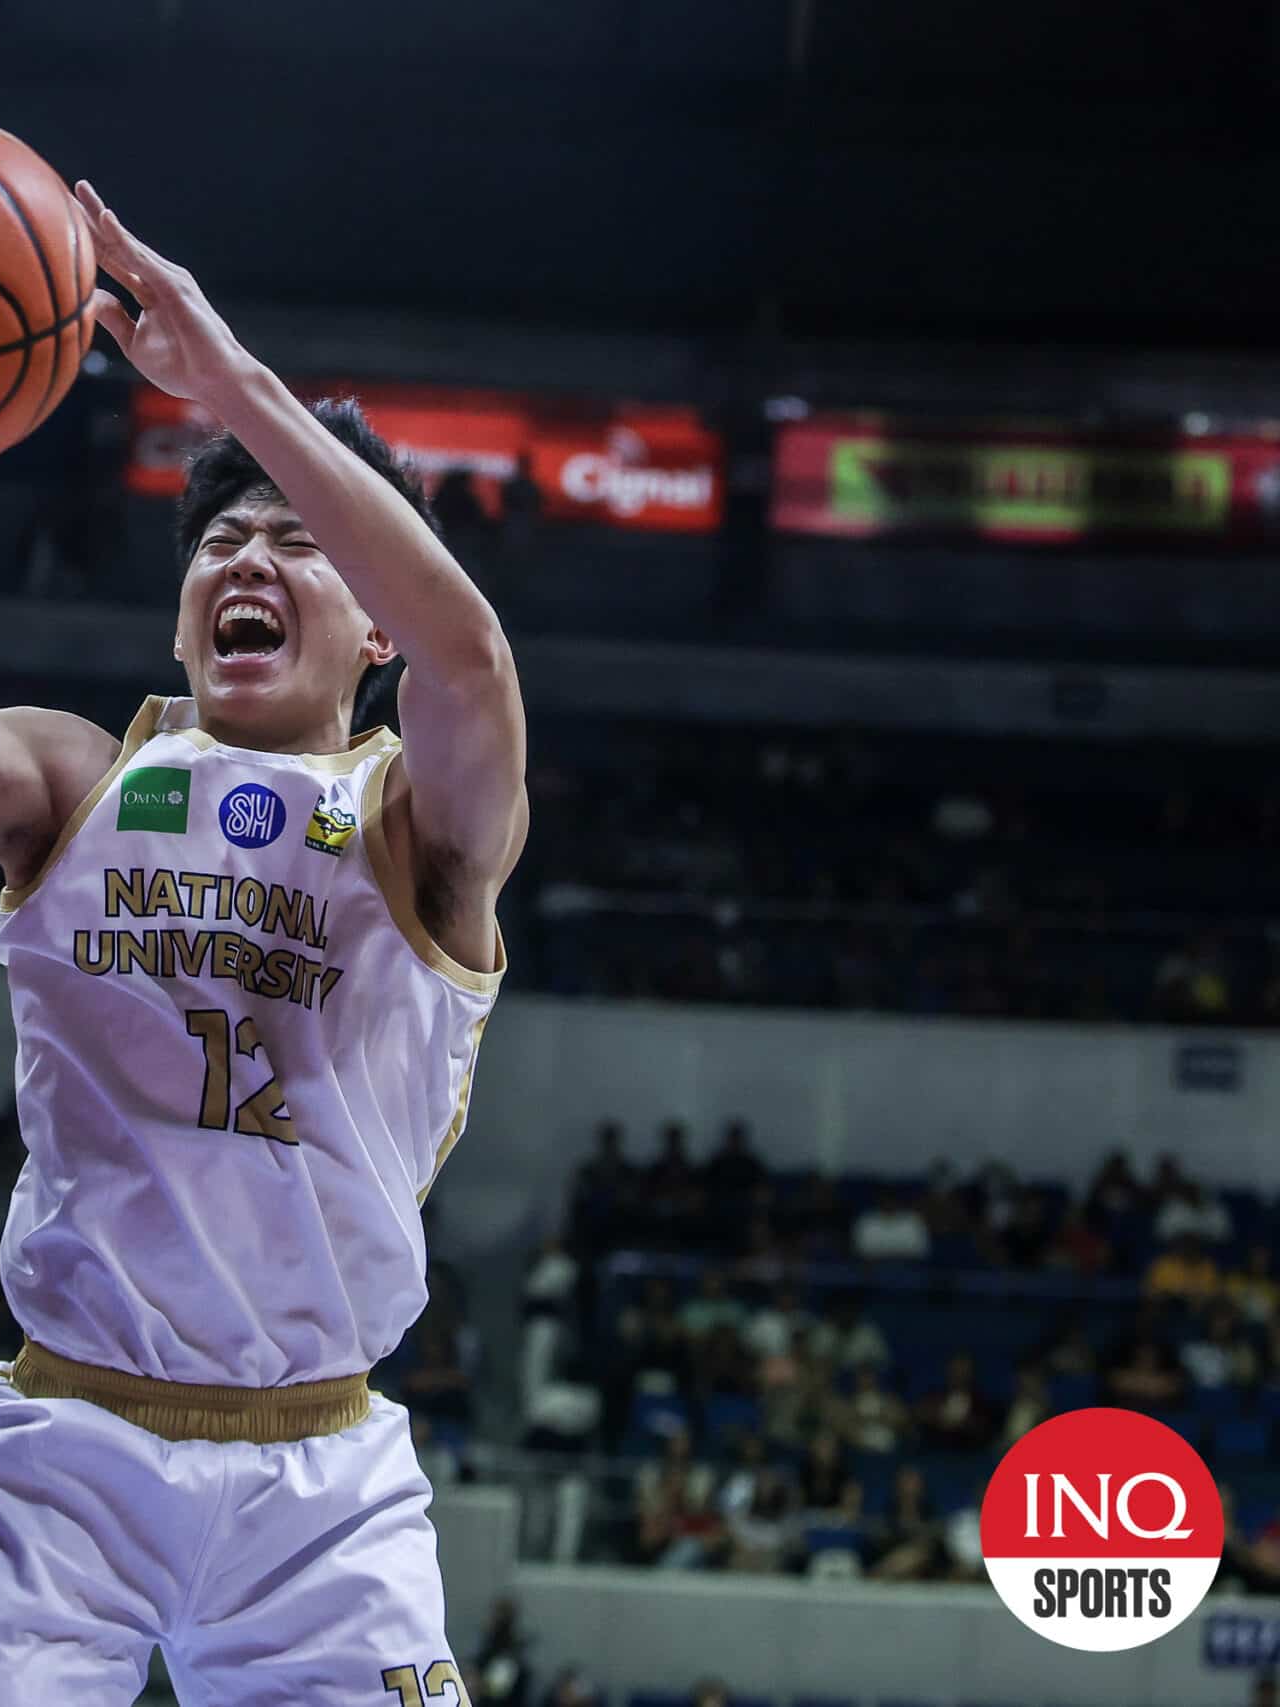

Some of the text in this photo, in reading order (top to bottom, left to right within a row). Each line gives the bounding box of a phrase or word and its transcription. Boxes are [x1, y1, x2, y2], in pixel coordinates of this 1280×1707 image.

[124, 791, 165, 805] OMNI
[104, 868, 328, 949] NATIONAL
[73, 929, 344, 1013] UNIVERSITY
[185, 1008, 299, 1146] 12
